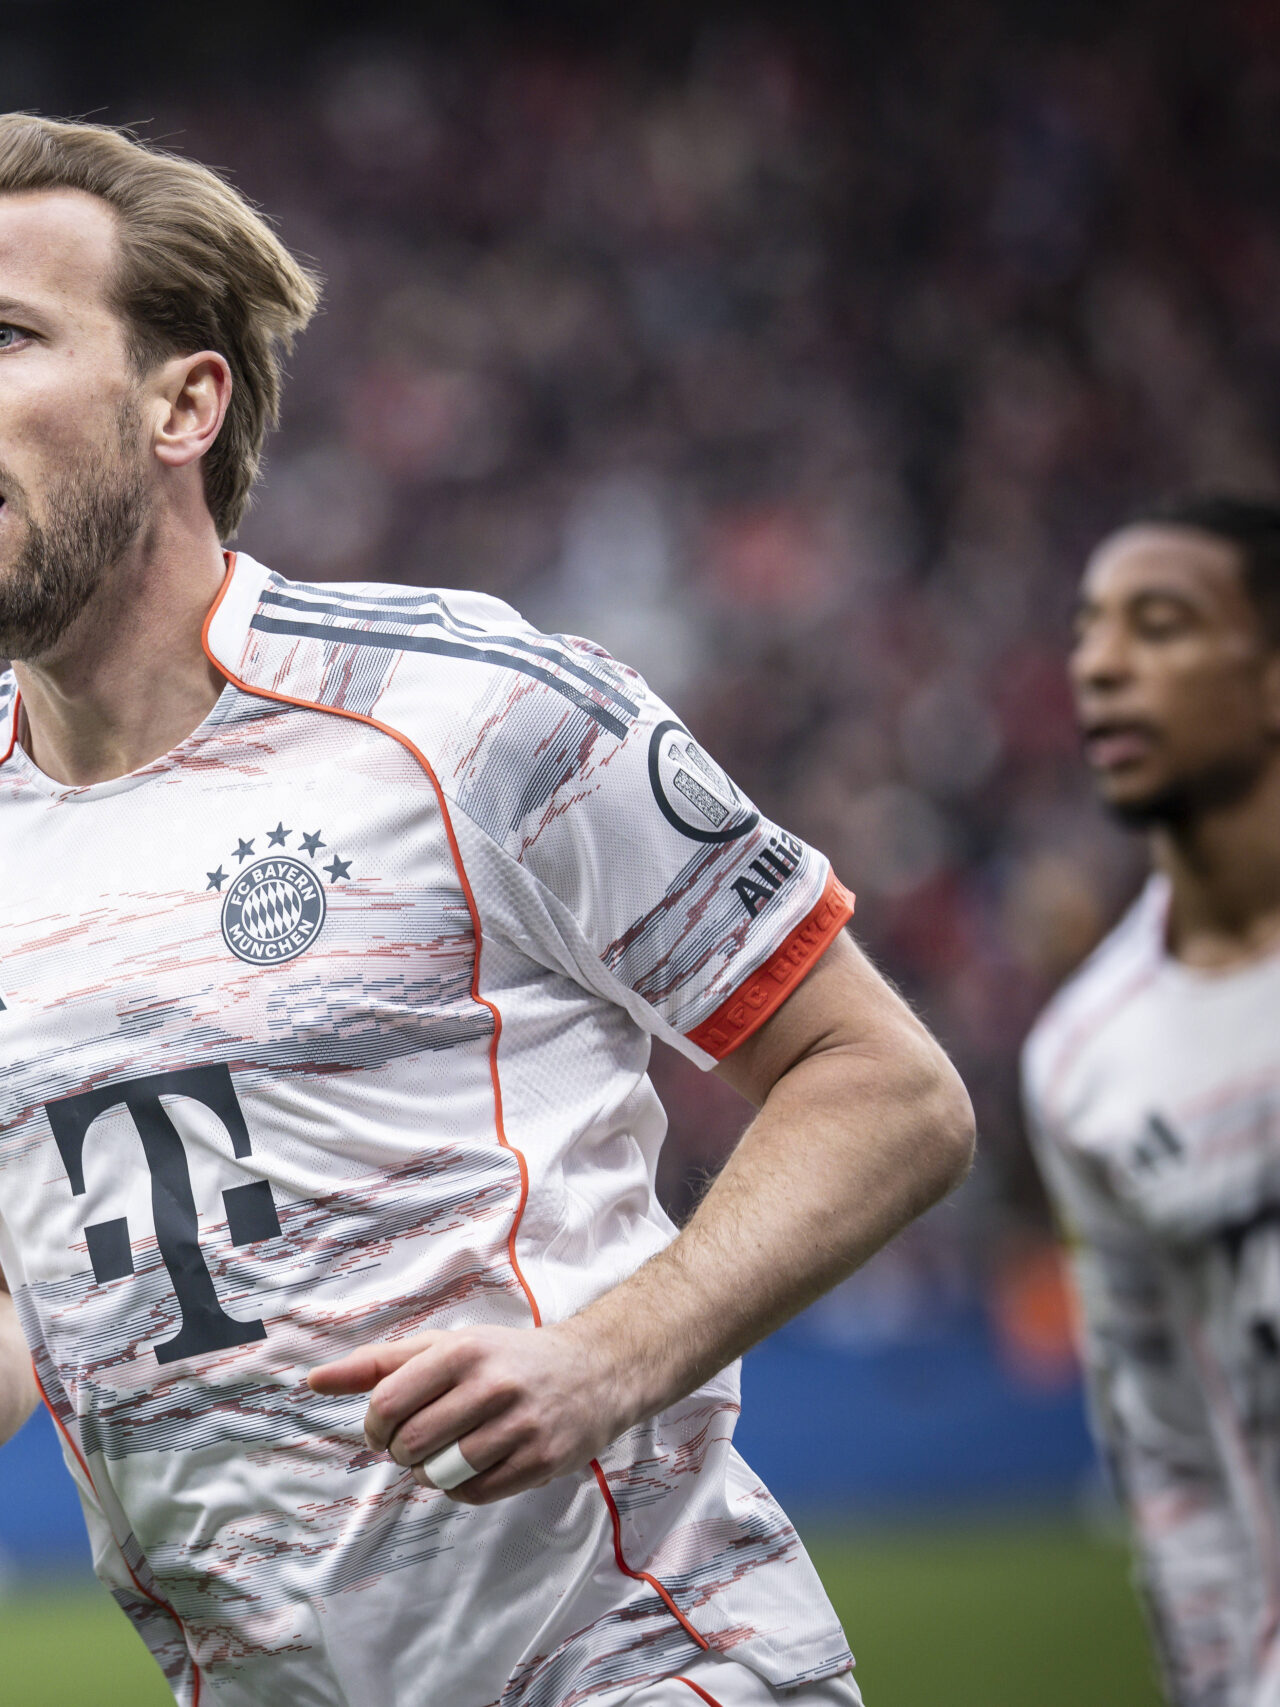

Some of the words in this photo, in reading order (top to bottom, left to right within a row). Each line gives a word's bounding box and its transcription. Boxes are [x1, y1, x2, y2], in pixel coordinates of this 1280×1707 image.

[231, 881, 250, 906] FC
[252, 864, 317, 901] BAYERN
[229, 919, 314, 958] MÜNCHEN
[44, 1063, 282, 1365] T
